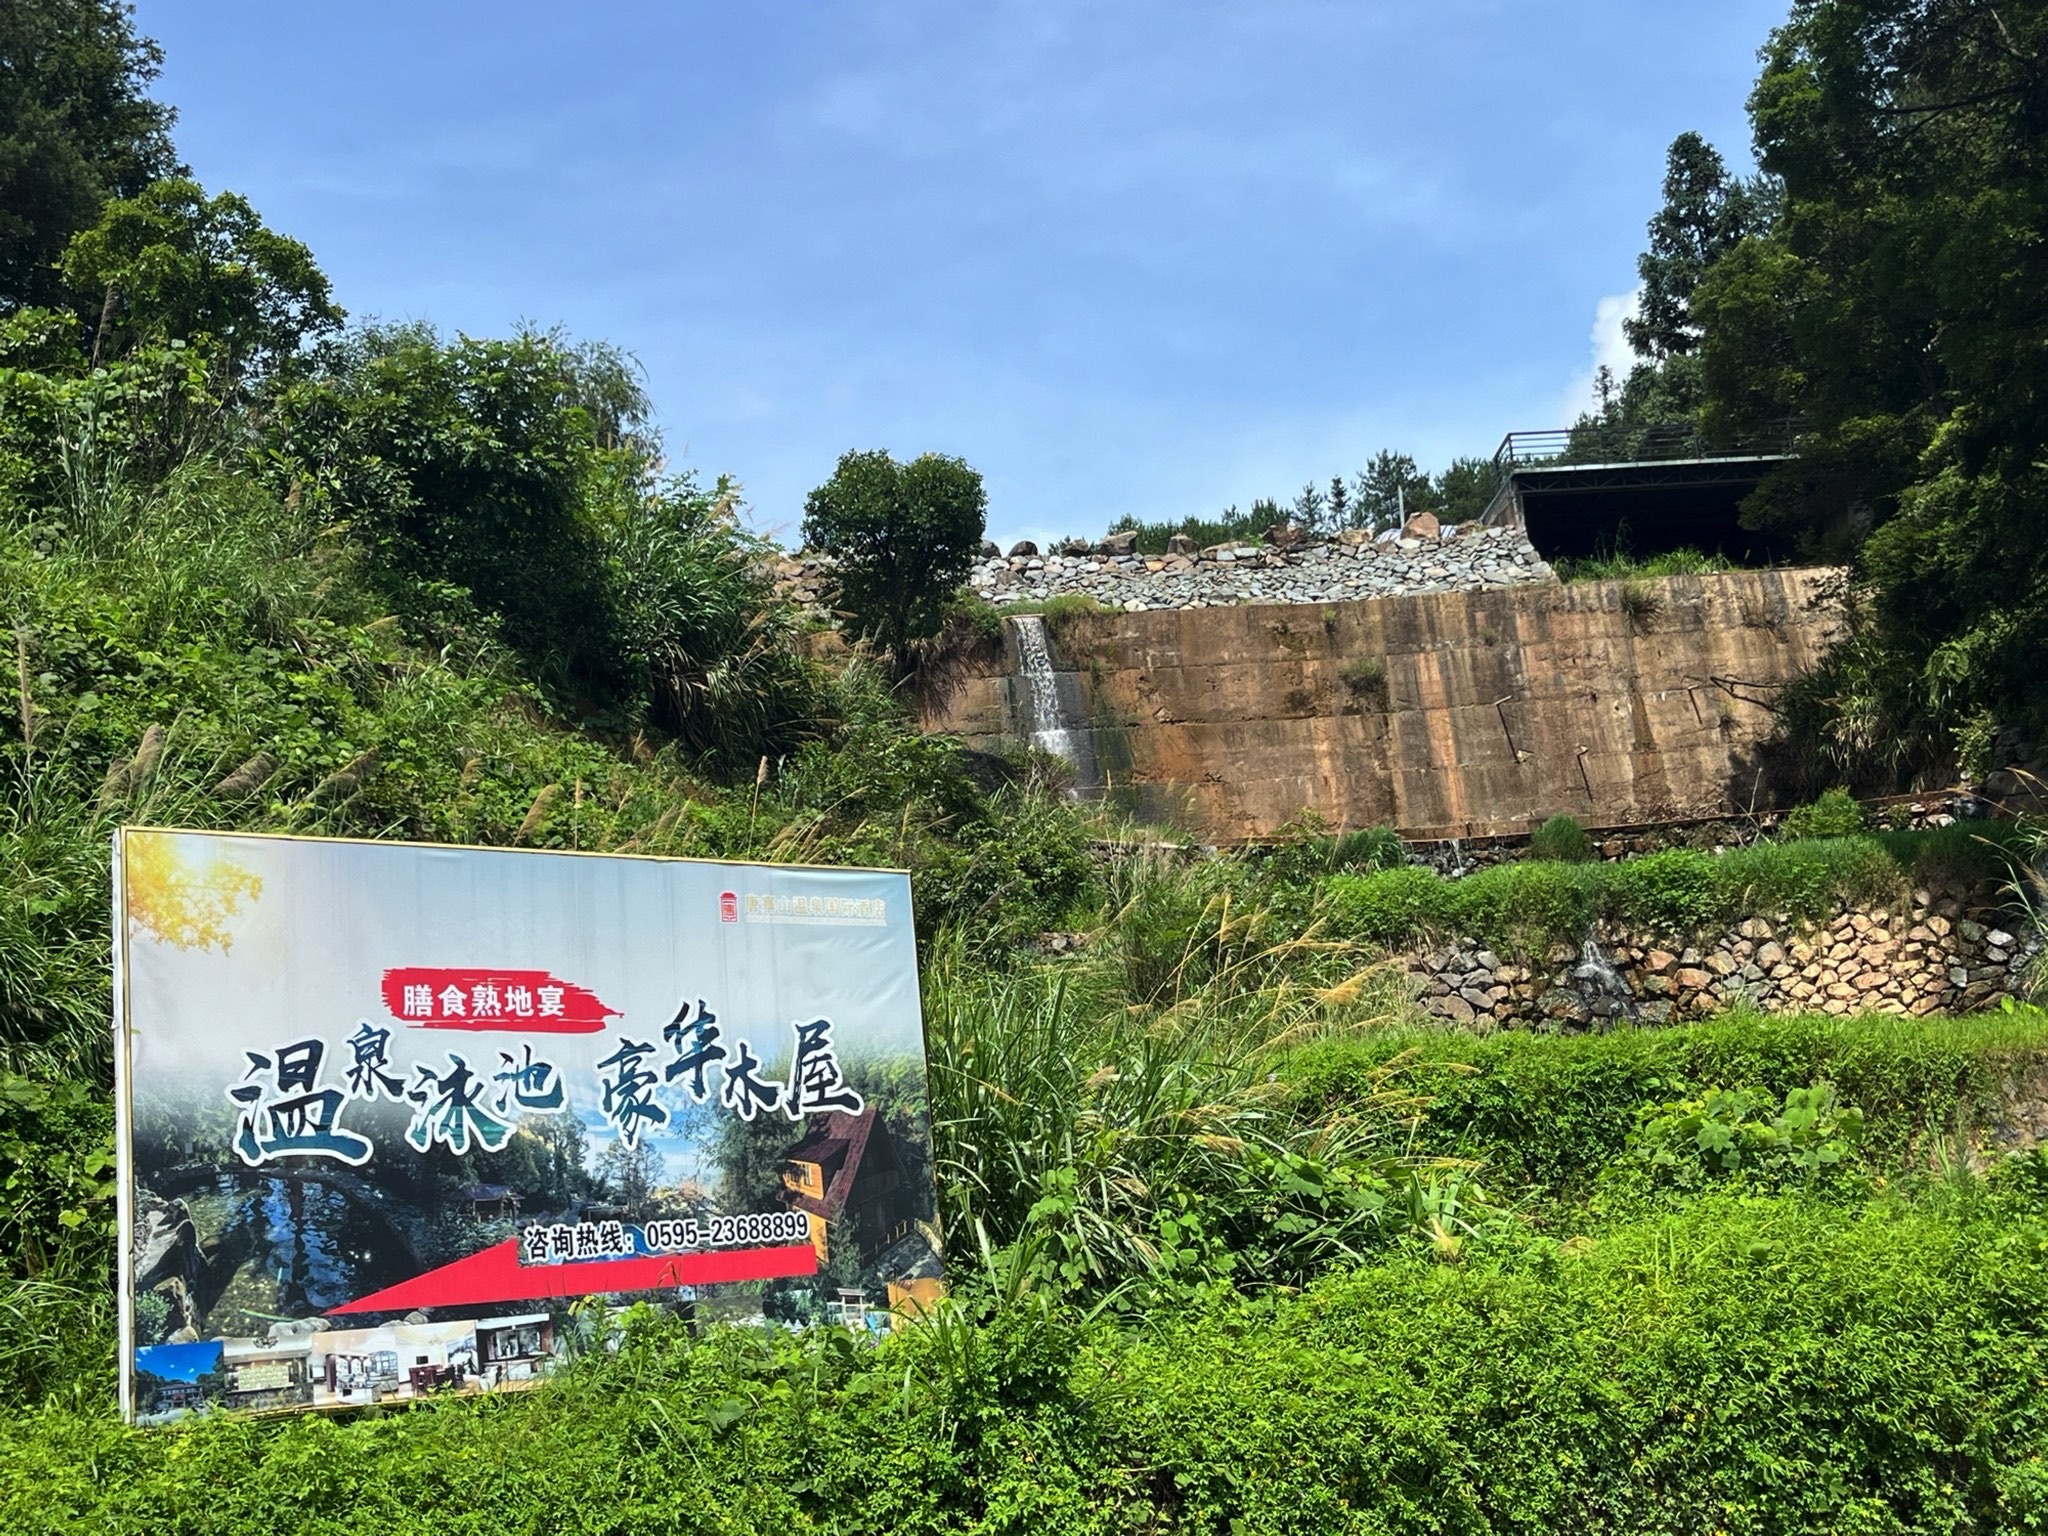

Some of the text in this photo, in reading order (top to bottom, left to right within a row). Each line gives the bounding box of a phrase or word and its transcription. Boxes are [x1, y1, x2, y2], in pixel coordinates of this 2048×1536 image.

[403, 984, 565, 1017] 膳食熟地宴
[230, 999, 860, 1161] 温泉泳池 豪华木屋
